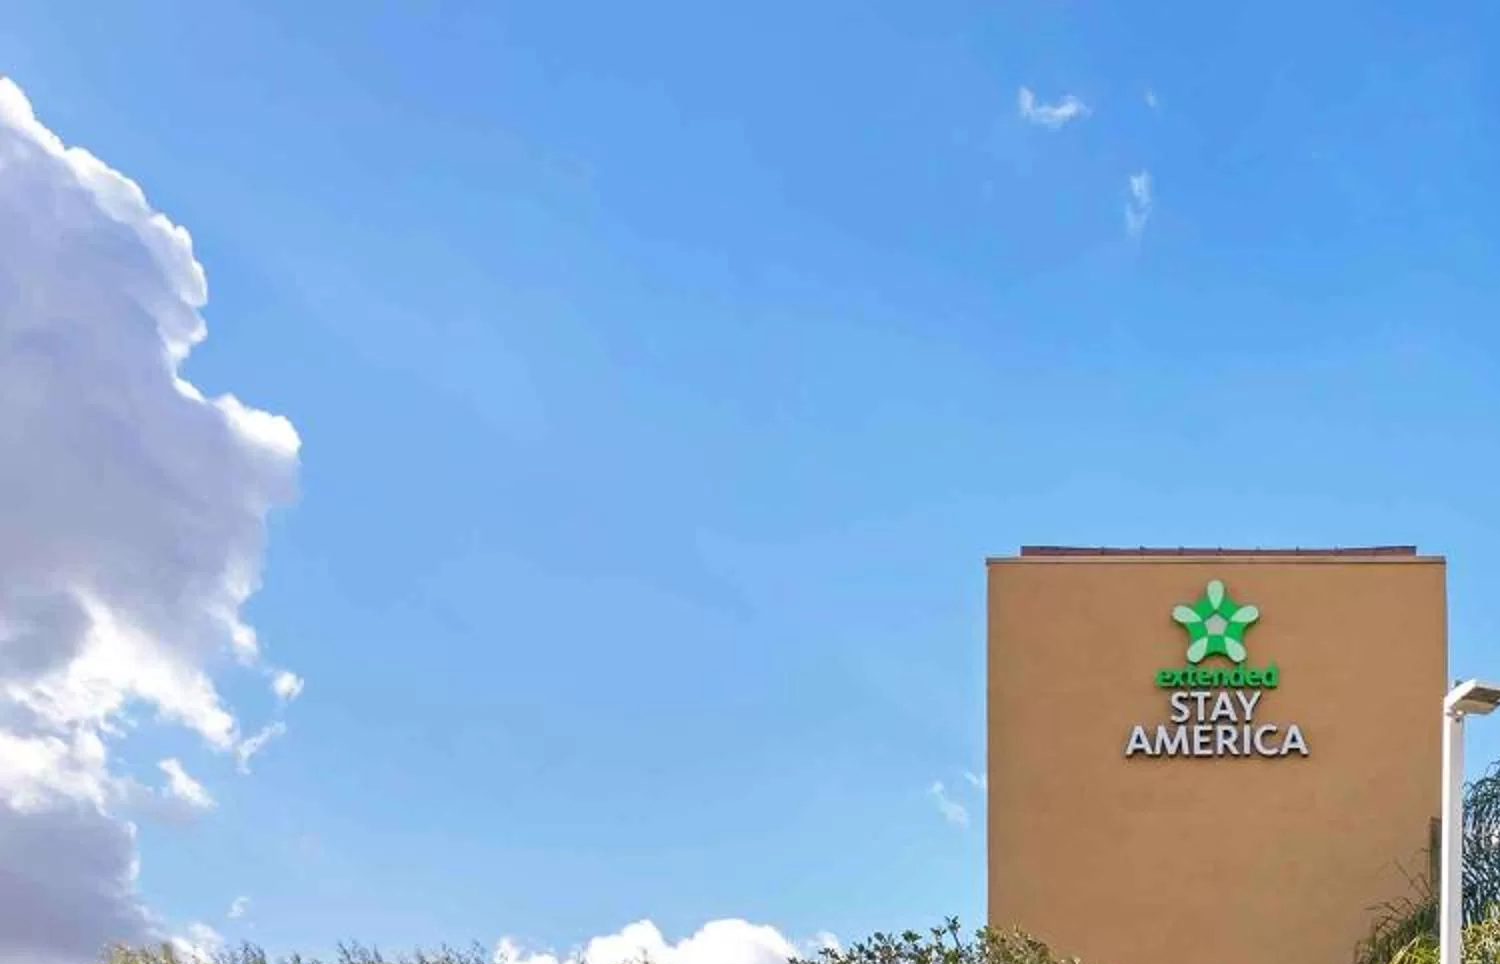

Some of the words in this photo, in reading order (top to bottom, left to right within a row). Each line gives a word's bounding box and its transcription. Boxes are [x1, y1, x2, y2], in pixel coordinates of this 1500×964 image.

[1156, 664, 1280, 687] extended
[1170, 690, 1262, 723] STAY
[1125, 724, 1310, 757] AMERICA
